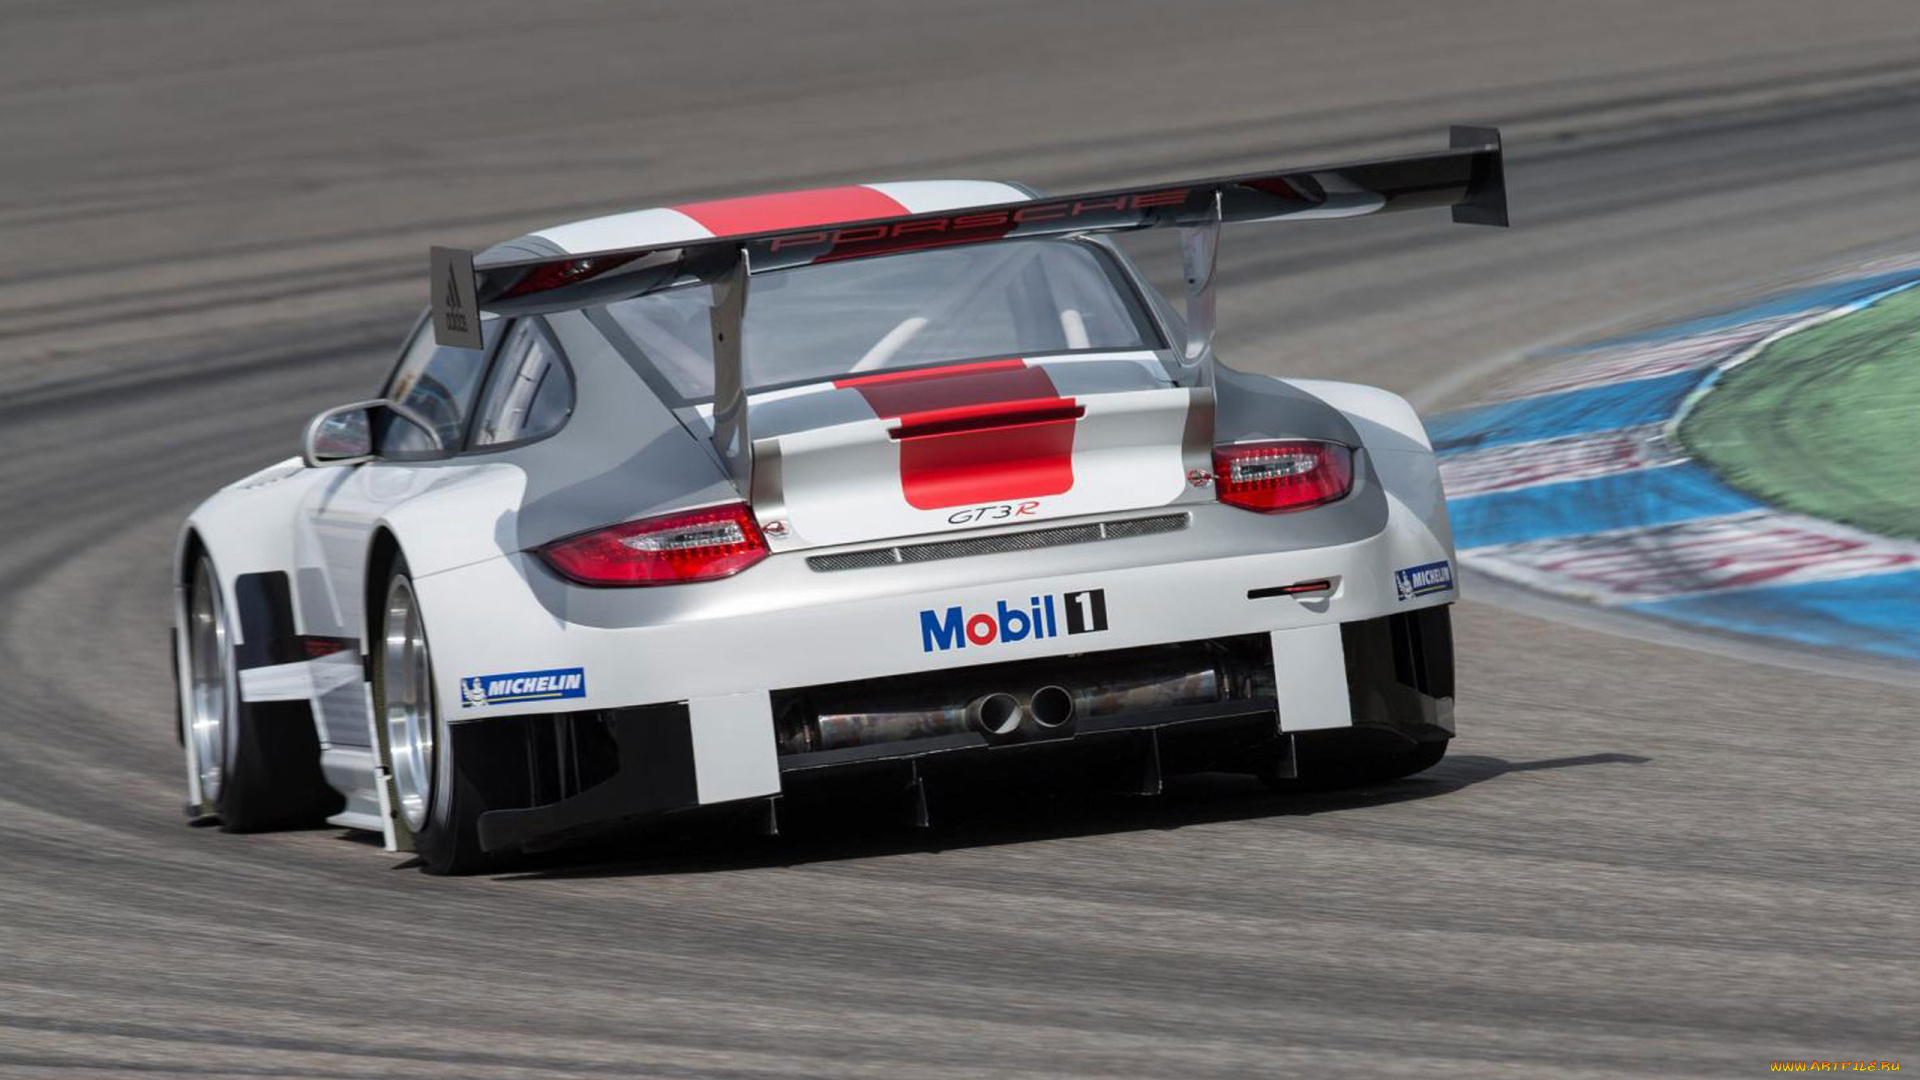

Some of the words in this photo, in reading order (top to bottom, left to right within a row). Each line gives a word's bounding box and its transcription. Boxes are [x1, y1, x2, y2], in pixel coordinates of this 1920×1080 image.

[770, 189, 1188, 253] PORSCHE
[1412, 567, 1451, 589] MICHELIN
[920, 594, 1057, 652] Mobil
[1074, 591, 1095, 632] 1
[488, 674, 582, 697] MICHELIN
